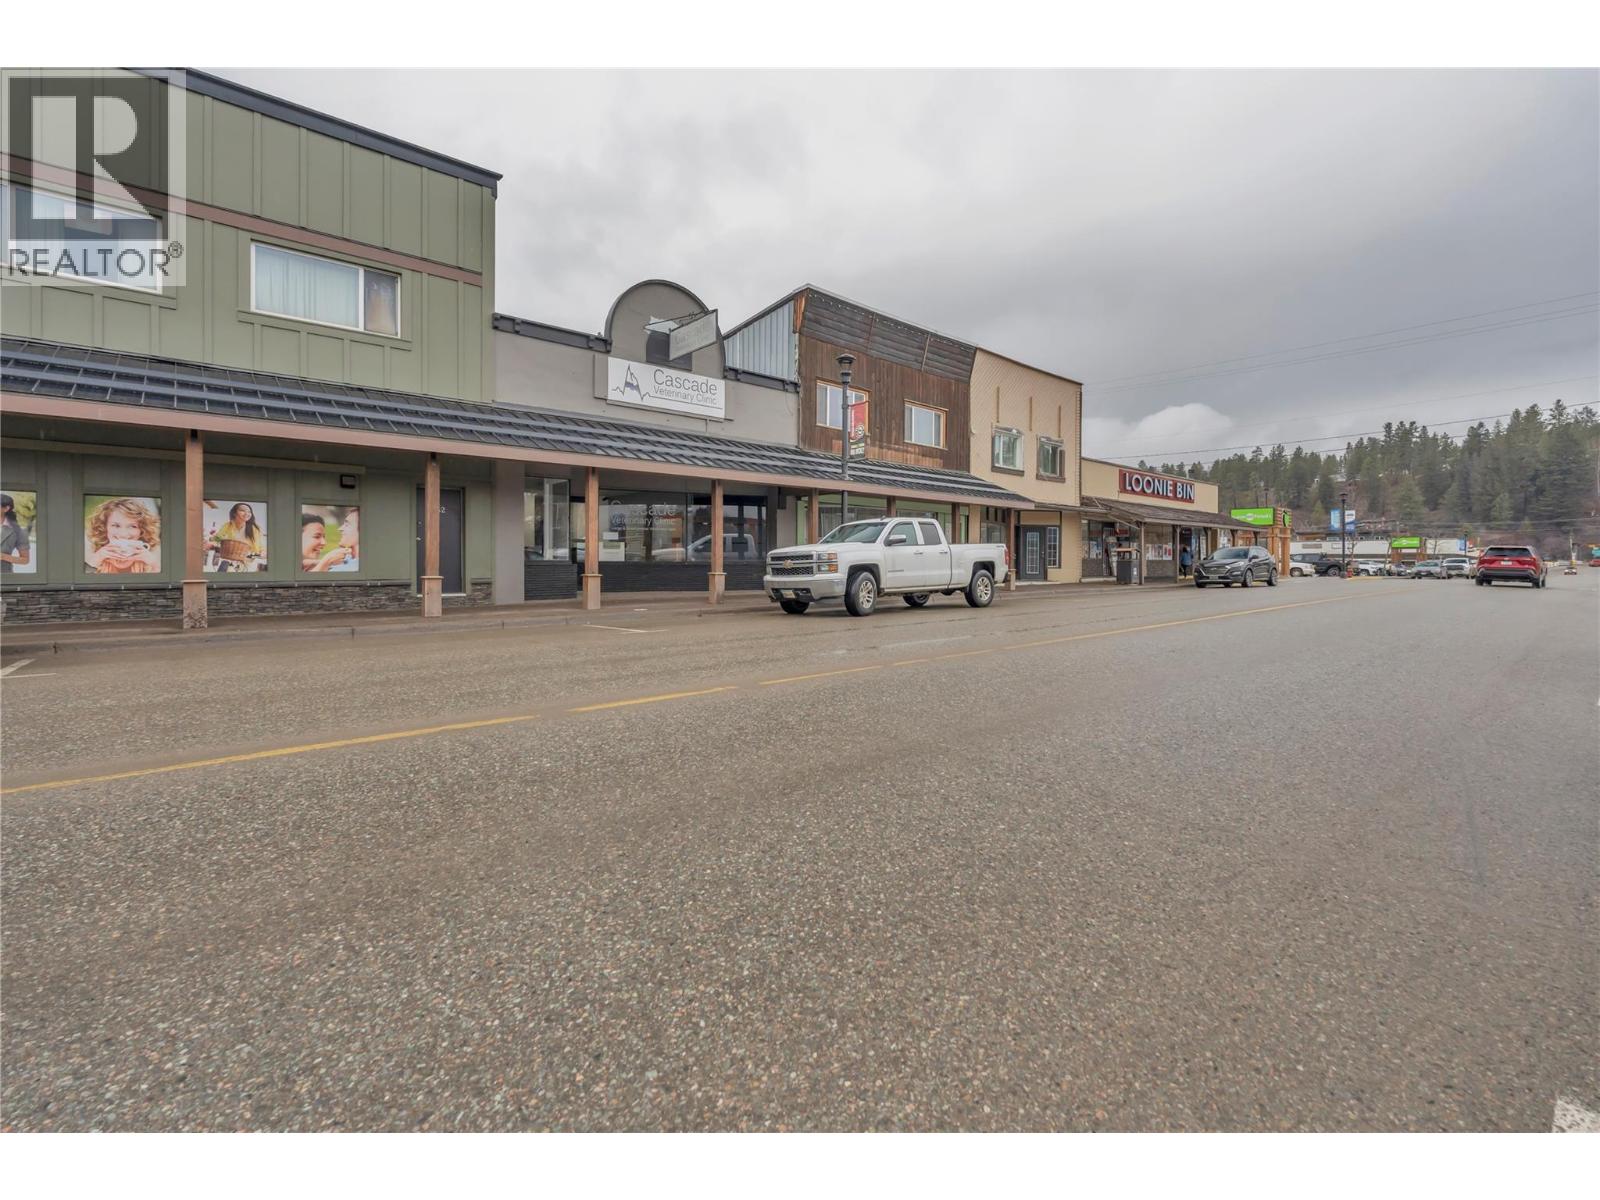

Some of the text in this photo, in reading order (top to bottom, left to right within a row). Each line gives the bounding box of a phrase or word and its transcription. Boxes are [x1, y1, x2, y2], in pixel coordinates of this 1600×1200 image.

[653, 368, 717, 396] Cascade
[653, 385, 718, 406] Veterinary Clinic
[1126, 472, 1195, 500] LOONIE BIN
